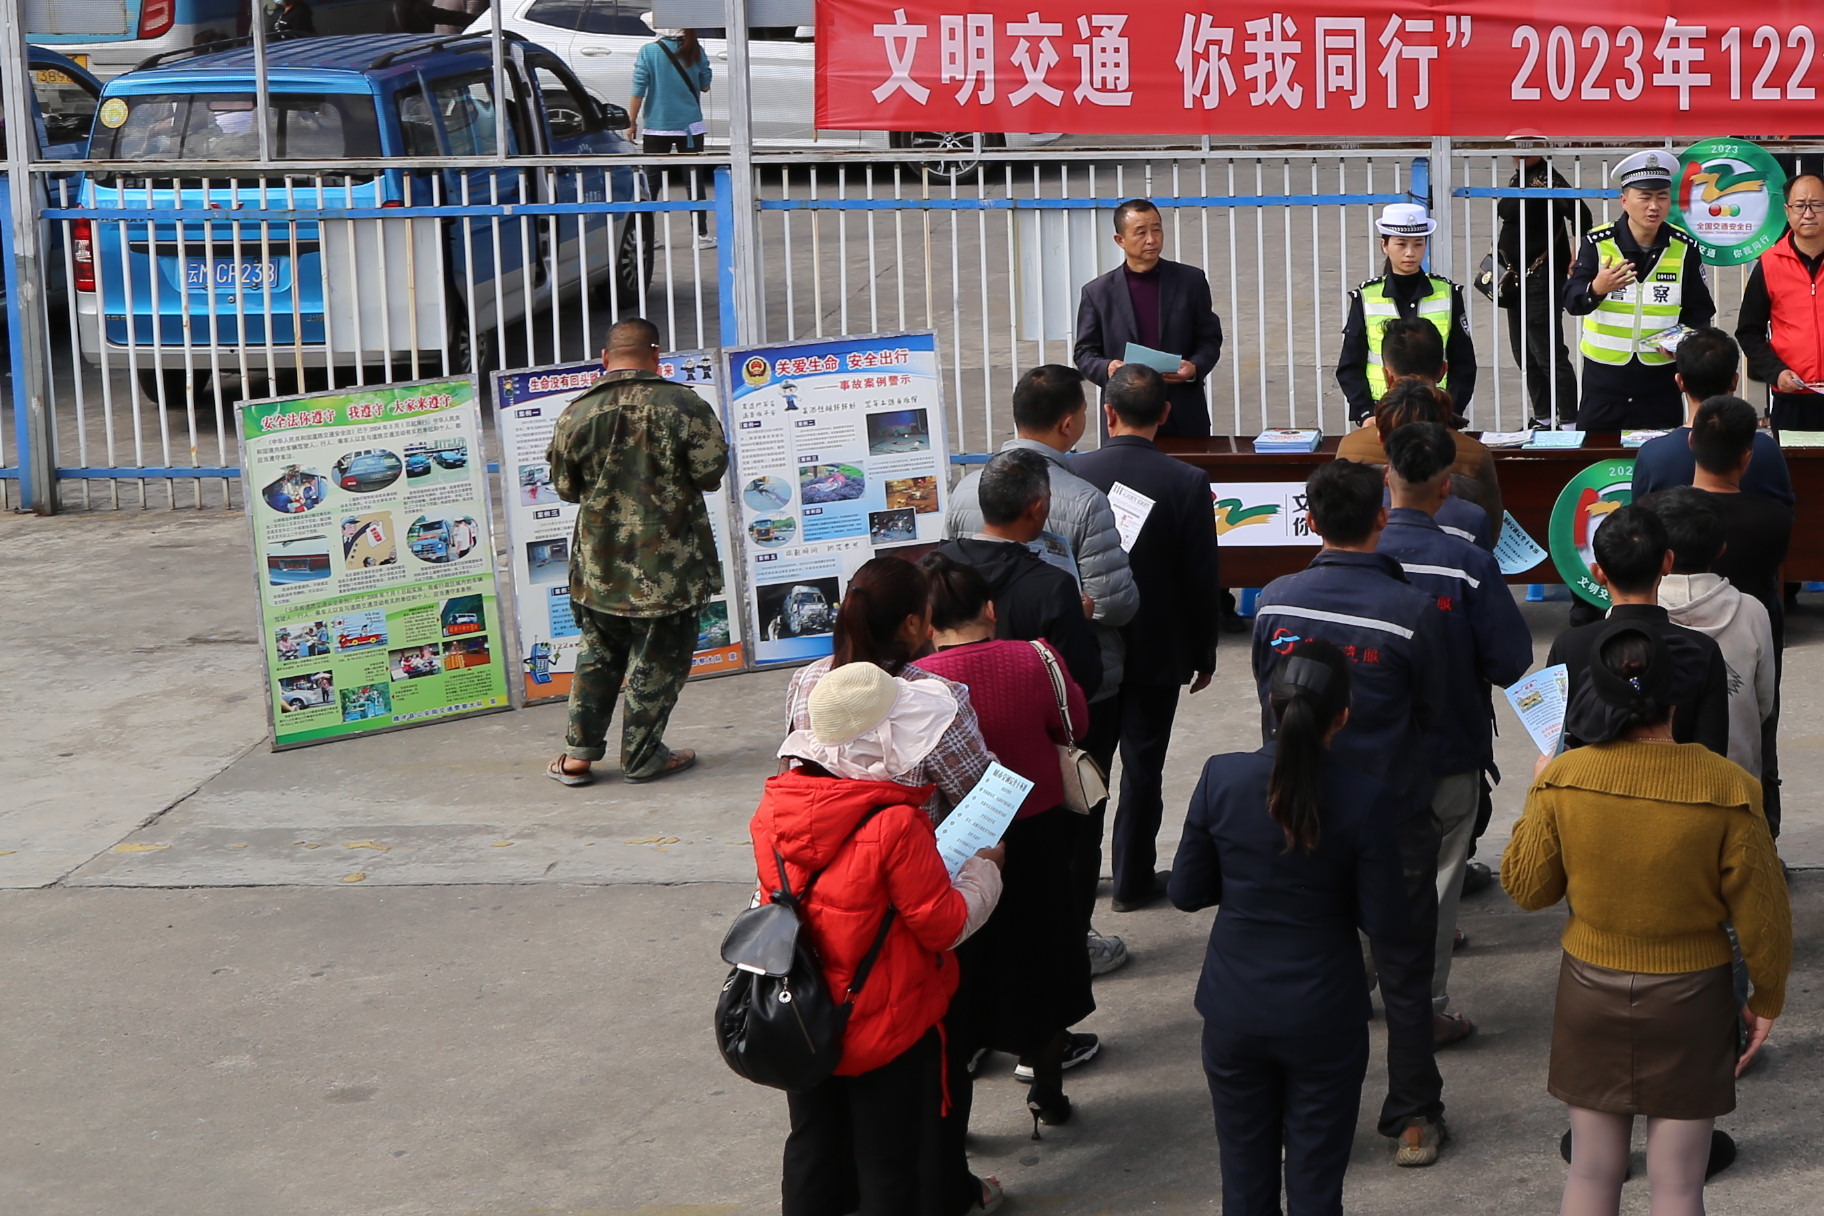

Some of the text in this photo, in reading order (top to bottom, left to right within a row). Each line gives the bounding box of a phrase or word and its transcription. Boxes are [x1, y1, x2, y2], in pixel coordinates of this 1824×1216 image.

[871, 7, 1134, 109] 文明交通
[1711, 144, 1739, 154] 2023
[1696, 222, 1752, 231] 全国交通安全日
[1733, 234, 1770, 259] 你我同行
[775, 348, 909, 377] 关爱生命 安全出行
[261, 393, 452, 431] 安全法你遵守 我遵守 大家来遵守
